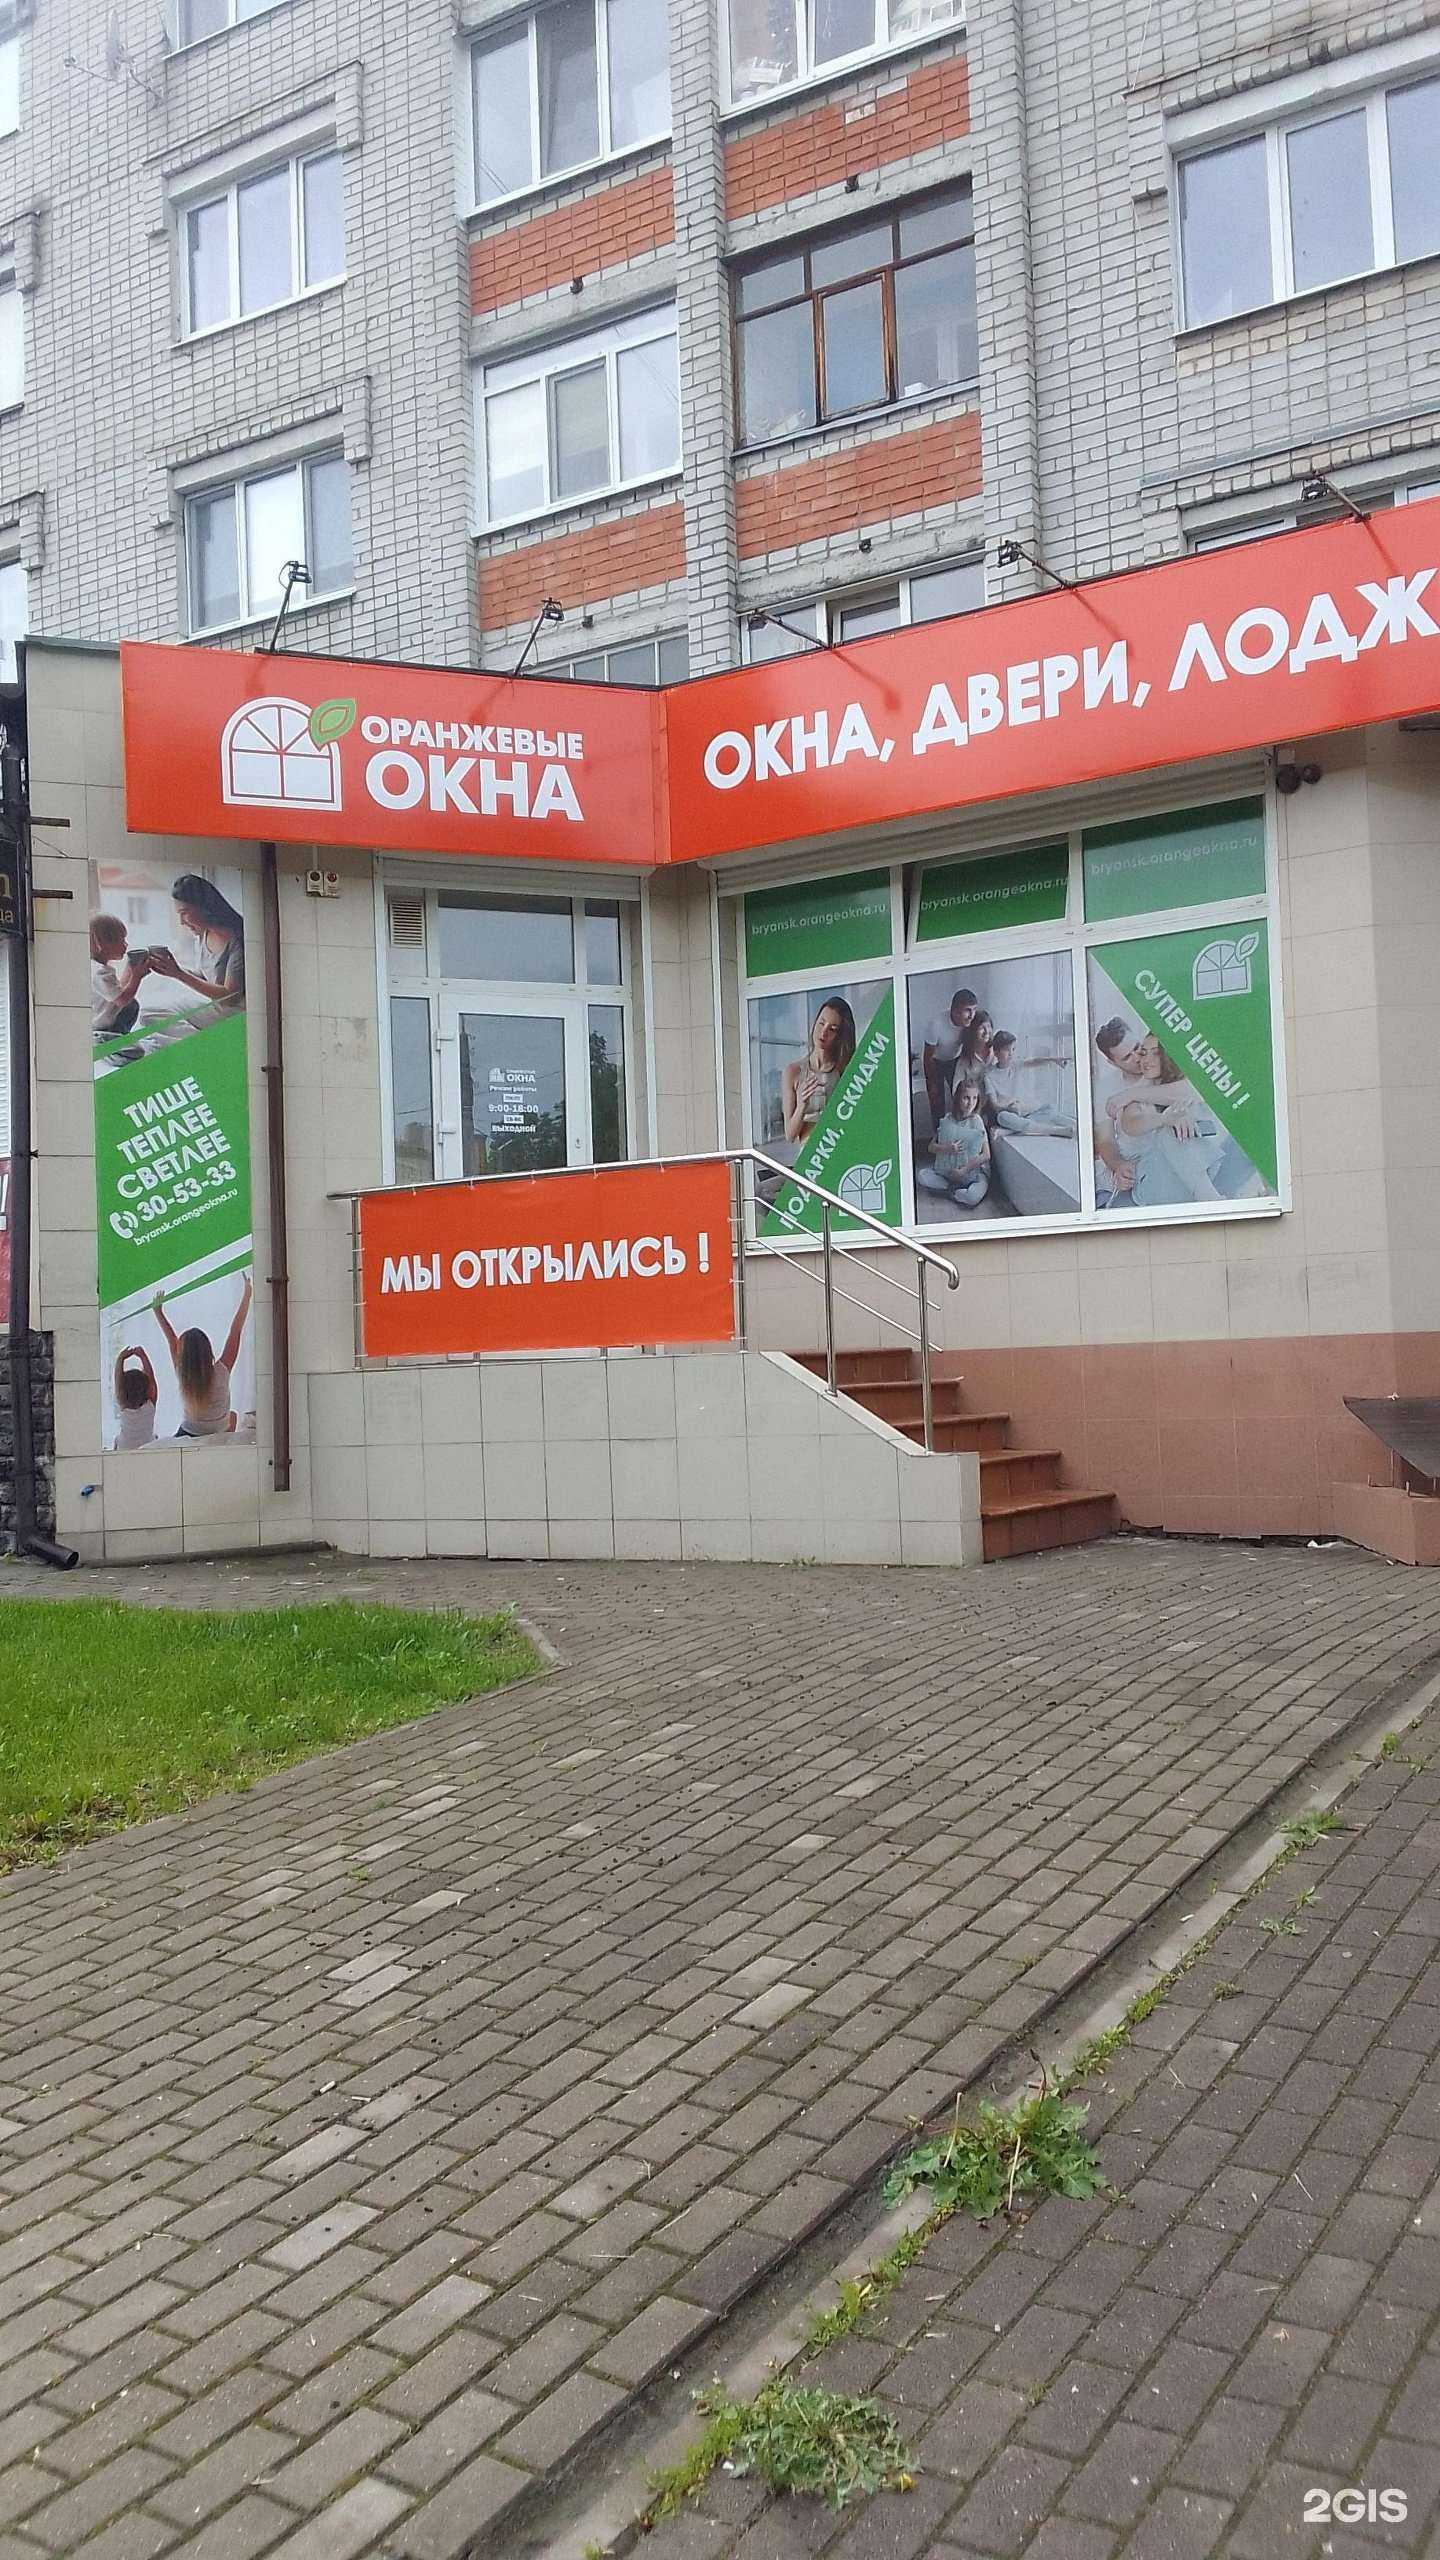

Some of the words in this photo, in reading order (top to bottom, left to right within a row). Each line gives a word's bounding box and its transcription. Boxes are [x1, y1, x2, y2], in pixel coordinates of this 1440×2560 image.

[360, 715, 584, 761] ОРАНЖЕВЫЕ
[703, 702, 895, 790] ОКНА,
[912, 640, 1151, 756] ДВЕРИ,
[364, 749, 584, 821] ОКНА
[751, 903, 886, 936] bryansk.orangeokna.ru
[1134, 969, 1193, 1033] СУПЕР
[123, 1076, 203, 1128] ТИШЕ
[506, 1073, 536, 1083] ОКНА
[836, 1031, 890, 1121] СКИДКИ
[116, 1102, 218, 1164] ТЕПЛЕЕ
[117, 1128, 231, 1199] СВЕТЛЕЕ
[133, 1188, 238, 1246] bryansk.orangeokna.ru
[137, 1160, 237, 1222] 30-53-33
[380, 1252, 441, 1294] МЫ
[451, 1235, 686, 1289] ОТКРЫЛИСЬ
